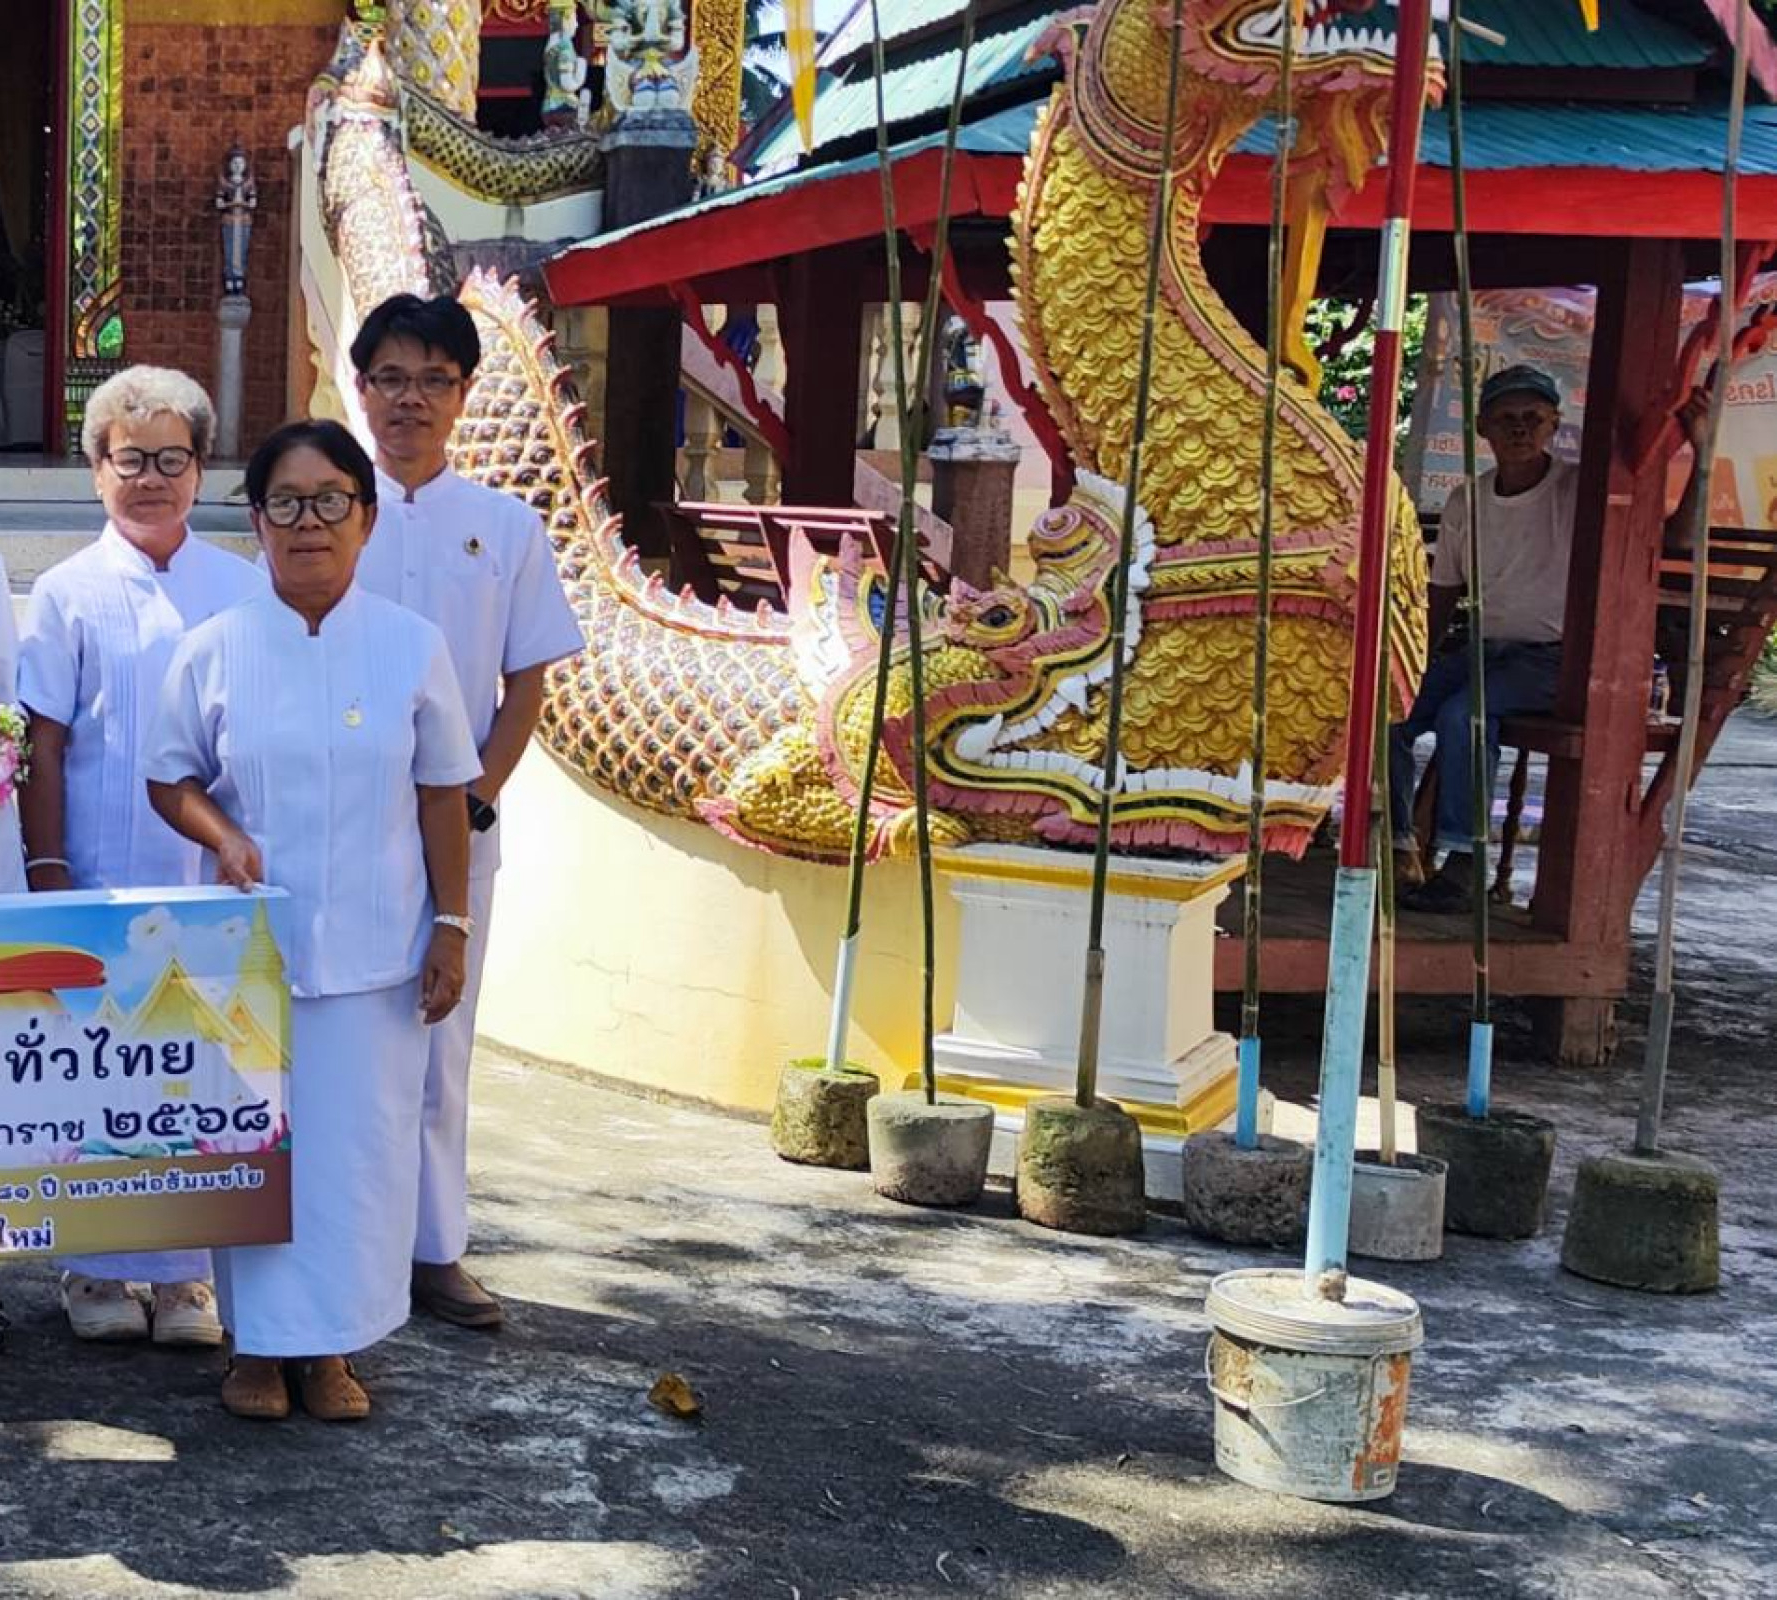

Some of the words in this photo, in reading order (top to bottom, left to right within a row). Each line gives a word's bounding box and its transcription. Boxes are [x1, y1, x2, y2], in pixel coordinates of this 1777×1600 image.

[104, 1099, 271, 1139] ๒๕๖๘
[41, 1175, 58, 1198] ปี
[67, 1165, 263, 1197] หลวงพ่อธัมมชโย
